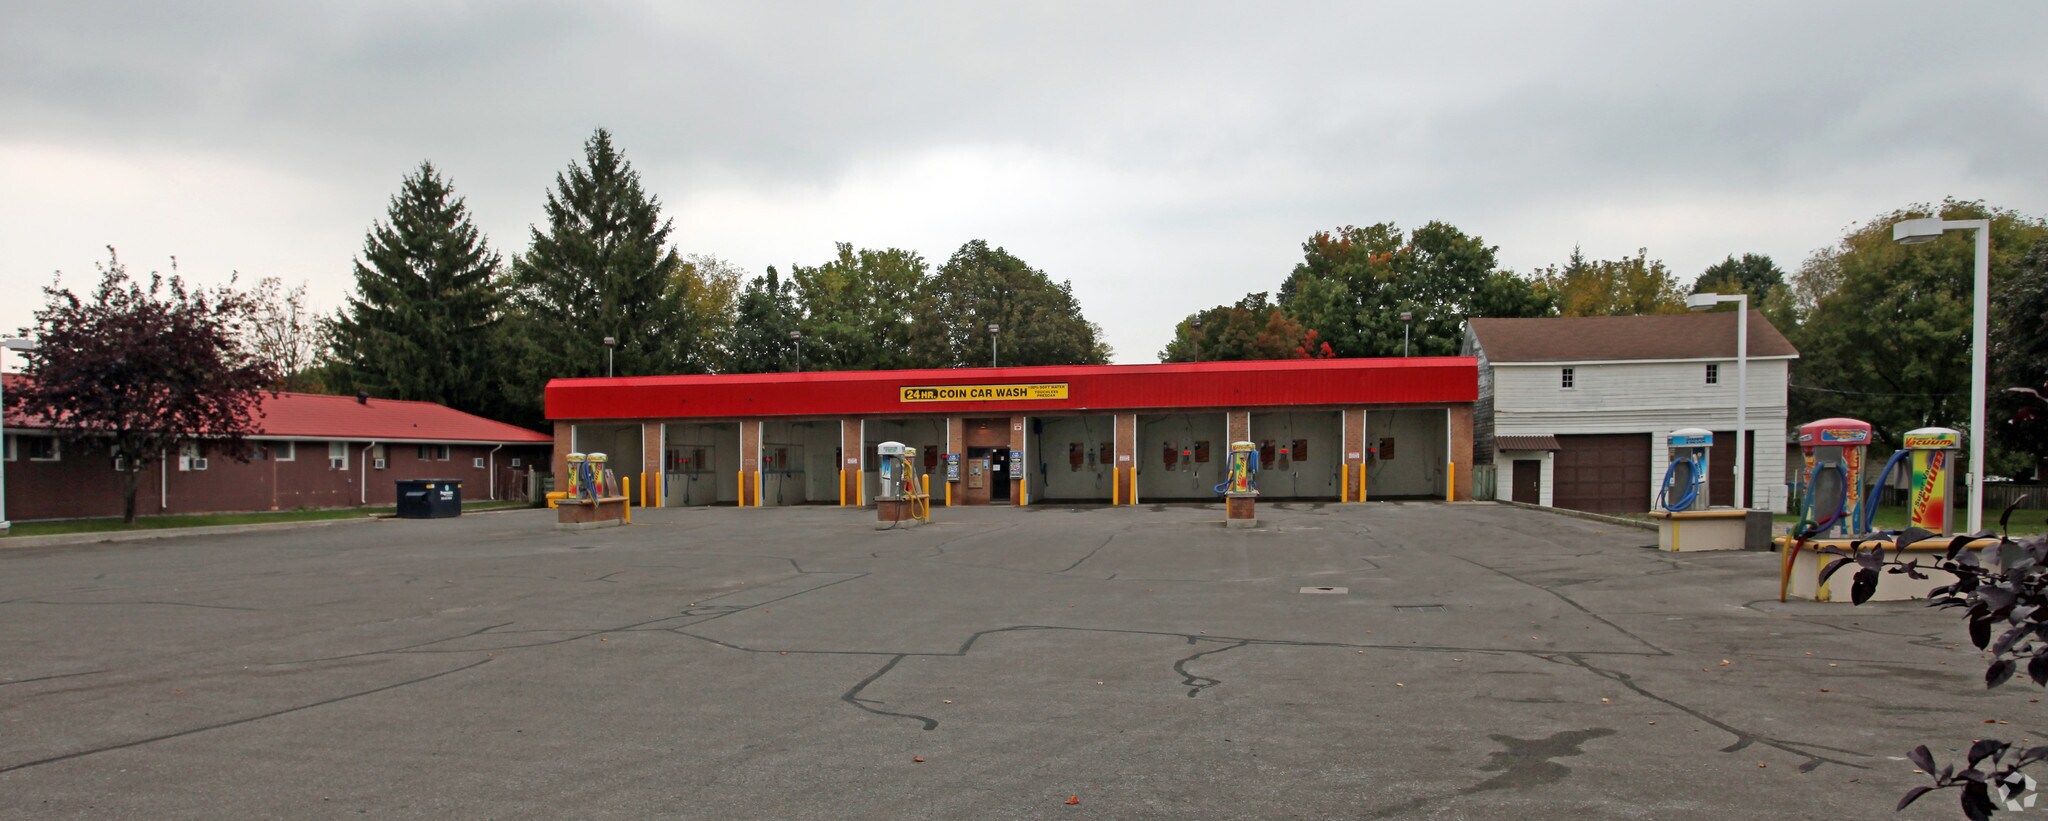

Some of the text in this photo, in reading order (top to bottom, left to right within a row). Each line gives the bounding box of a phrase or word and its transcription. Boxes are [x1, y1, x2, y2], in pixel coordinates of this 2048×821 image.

[906, 388, 1028, 399] 24 HR. COIN CAR WASH
[1905, 437, 1953, 447] Vacuum
[1912, 450, 1945, 524] Vacuum
[1915, 464, 1932, 506] Super Vac
